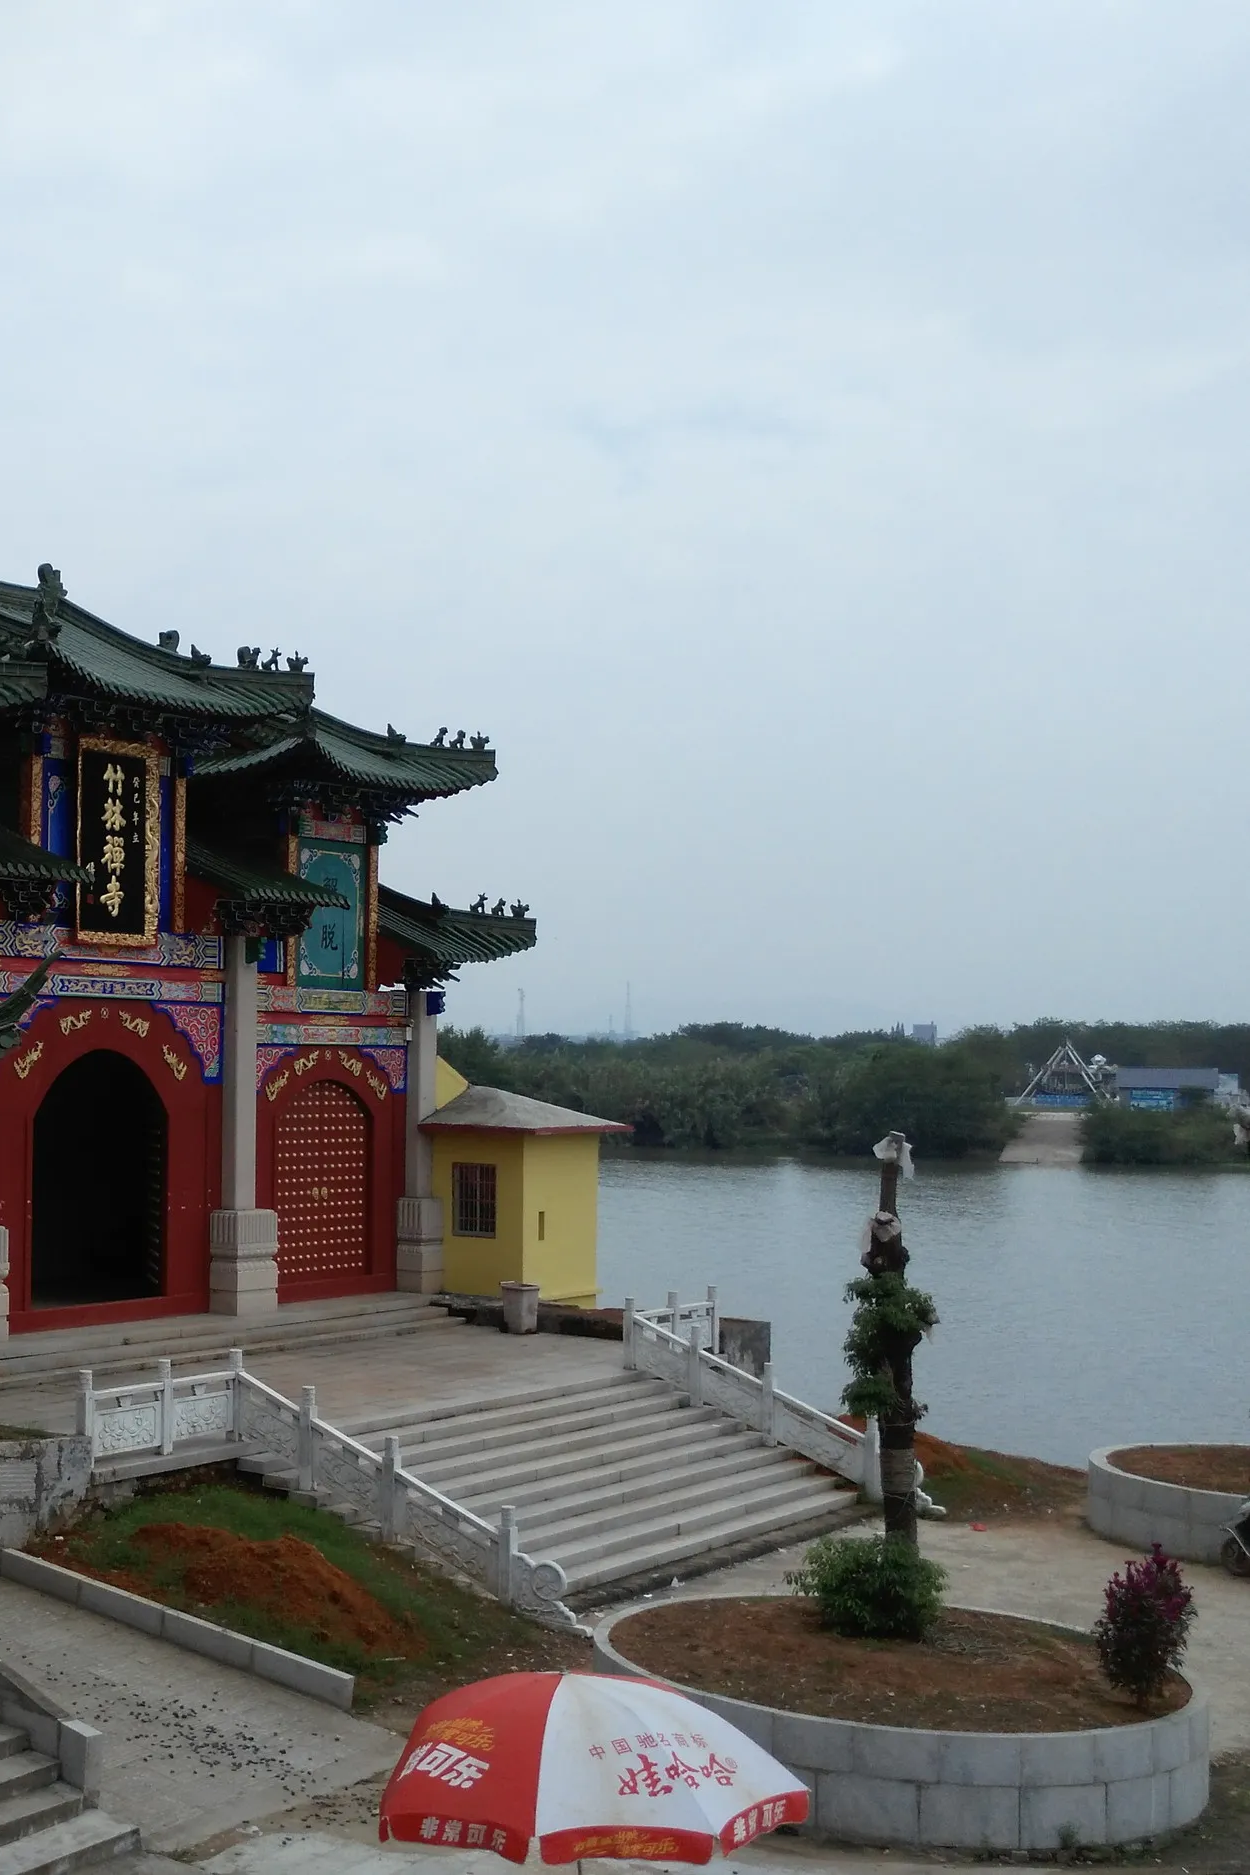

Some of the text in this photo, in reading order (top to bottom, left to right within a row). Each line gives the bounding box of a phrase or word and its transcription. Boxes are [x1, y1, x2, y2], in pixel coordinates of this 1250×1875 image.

[100, 763, 127, 917] 竹林禪寺
[589, 1731, 708, 1760] 中国驰名商标
[617, 1751, 737, 1797] 娃哈哈
[419, 1816, 507, 1851] 非常可乐
[733, 1799, 786, 1843] 非常可乐
